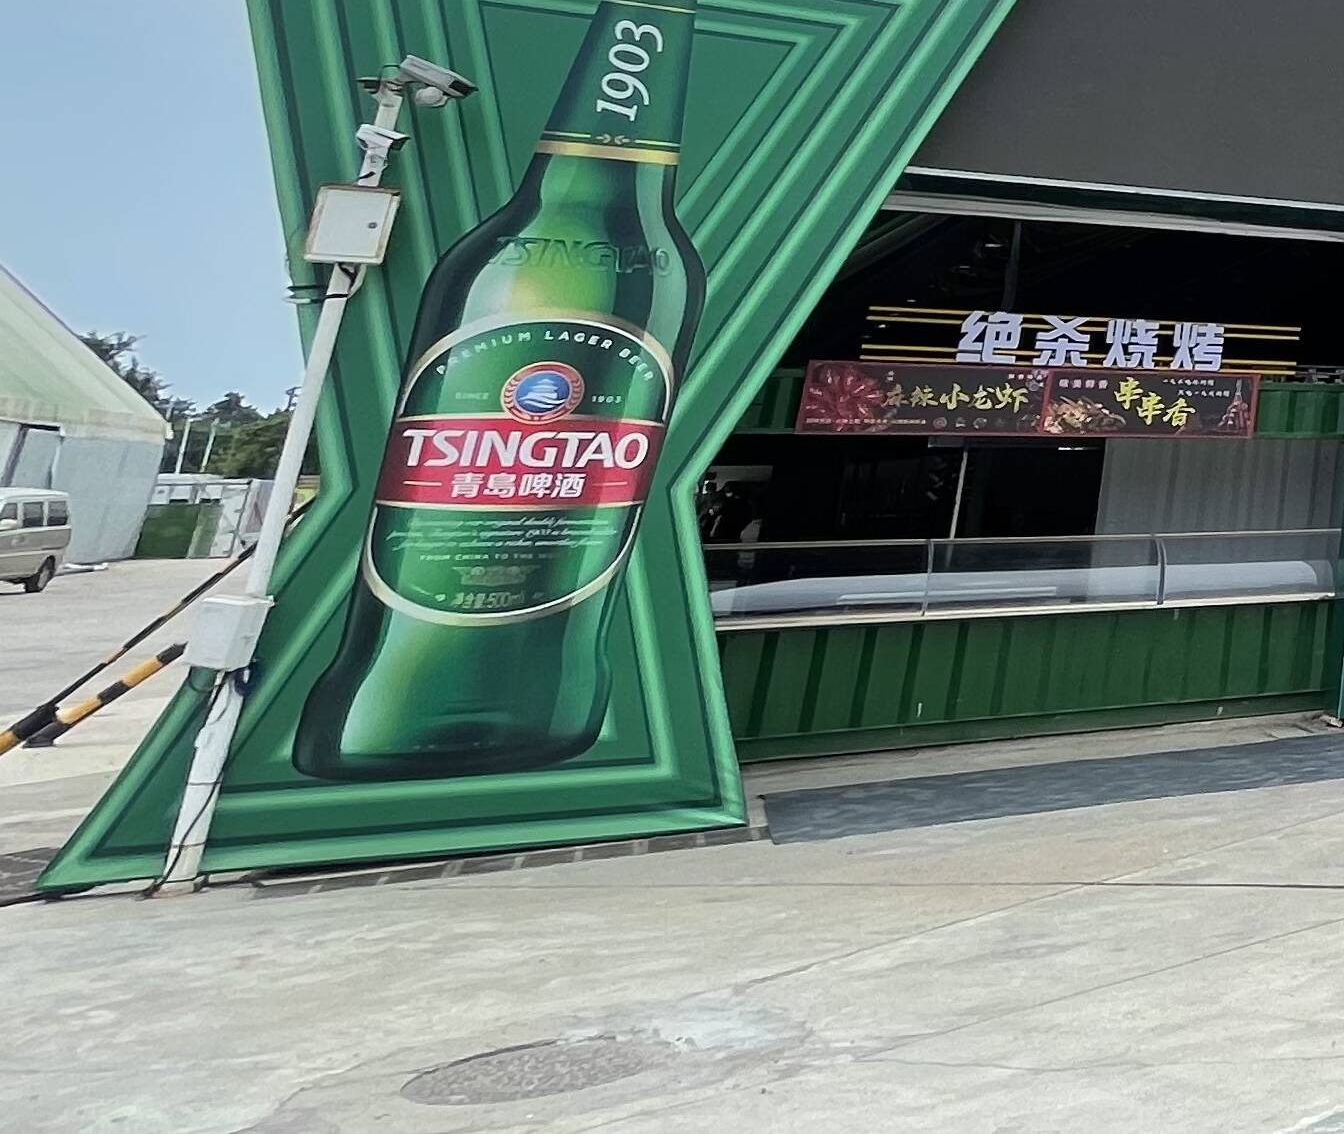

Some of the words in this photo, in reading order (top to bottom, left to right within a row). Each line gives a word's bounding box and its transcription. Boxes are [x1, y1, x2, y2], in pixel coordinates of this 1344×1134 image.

[596, 19, 663, 122] 1903
[435, 331, 532, 375] PREMIUM
[544, 330, 612, 351] LAGER
[617, 347, 655, 382] BEER
[955, 310, 1225, 372] 绝杀烧烤
[591, 394, 622, 404] 1903
[881, 382, 1029, 413] 麻辣小龙虾
[1113, 376, 1196, 427] 串串香
[402, 428, 649, 469] TSINGTAO
[455, 553, 490, 561] CHINA
